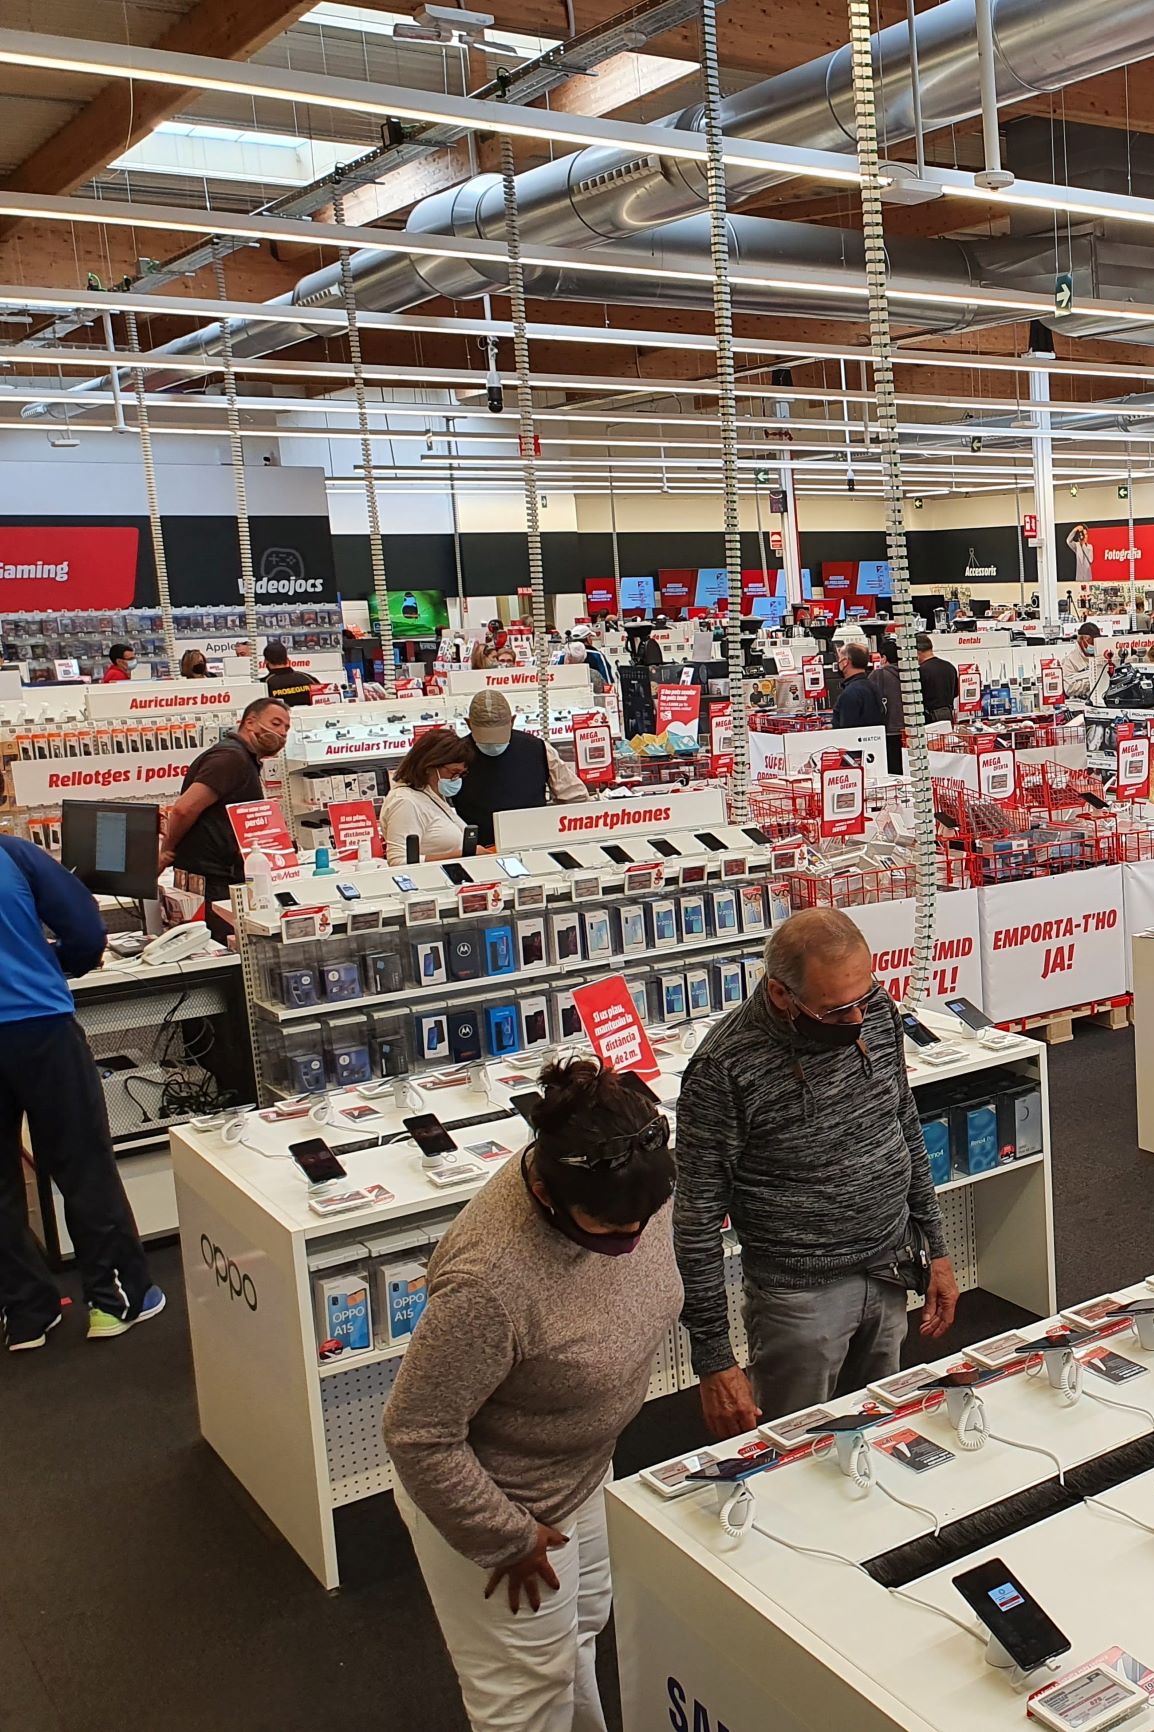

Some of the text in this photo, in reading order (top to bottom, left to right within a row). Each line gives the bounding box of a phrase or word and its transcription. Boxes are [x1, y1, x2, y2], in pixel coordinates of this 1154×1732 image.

[964, 565, 997, 577] Accessoris
[486, 675, 510, 686] True
[272, 685, 311, 697] PROSEGUR
[129, 691, 231, 710] Auriculars botó
[579, 731, 598, 741] MEGA
[326, 741, 380, 755] Auriculars
[383, 739, 406, 750] True
[1121, 744, 1139, 755] MEGA
[982, 757, 1001, 769] MEGA
[48, 769, 131, 789] Rellotges
[136, 765, 143, 781] i
[827, 775, 858, 790] MEGA OFERTA
[558, 807, 671, 832] Smartphones
[992, 909, 1118, 951] EMPORTA-T'HO
[1040, 944, 1075, 979] JA!
[605, 1032, 636, 1052] distància
[614, 1054, 624, 1064] de
[623, 1051, 628, 1061] 2
[200, 1233, 258, 1311] oppo
[393, 1292, 425, 1310] OPPO
[332, 1306, 365, 1324] OPPO
[394, 1307, 415, 1323] A15
[333, 1321, 355, 1336] A15
